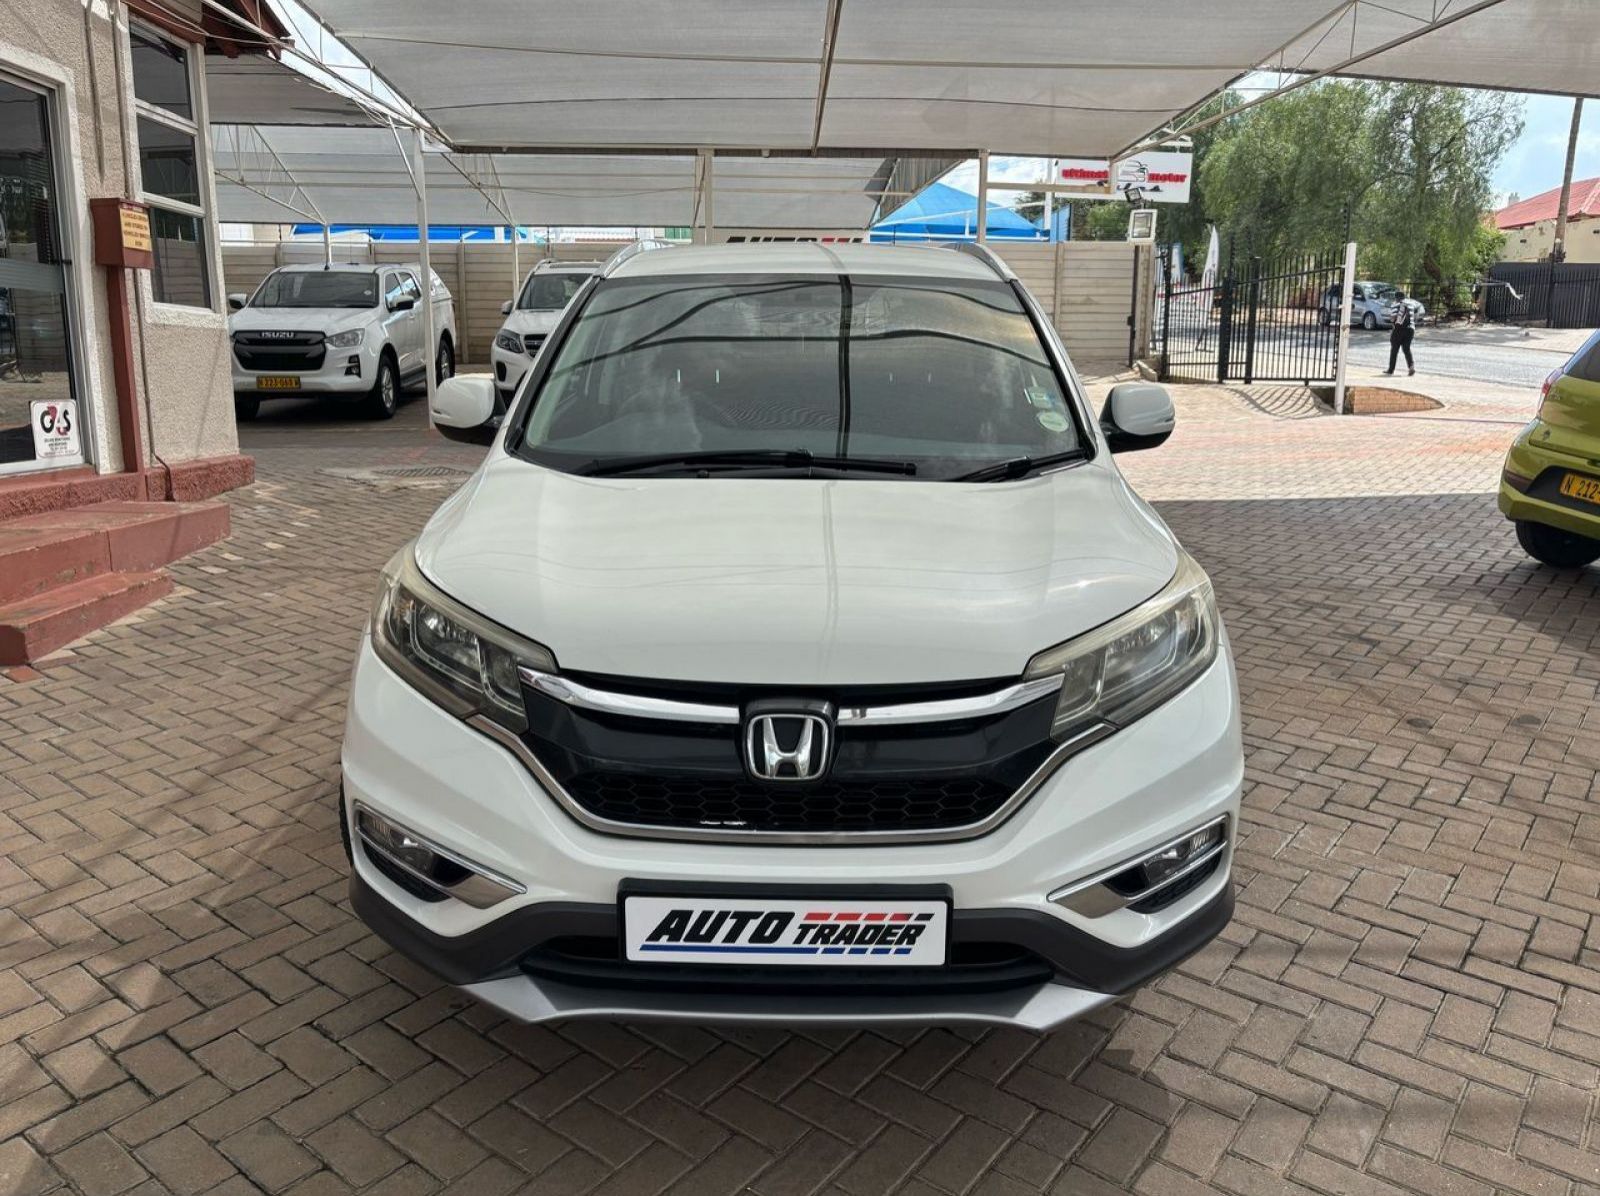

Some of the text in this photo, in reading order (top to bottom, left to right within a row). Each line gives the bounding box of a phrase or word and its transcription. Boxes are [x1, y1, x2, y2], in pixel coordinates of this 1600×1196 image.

[261, 331, 294, 339] ISUZU
[1564, 474, 1600, 499] N 212-
[645, 909, 926, 946] AUTO TRADER
